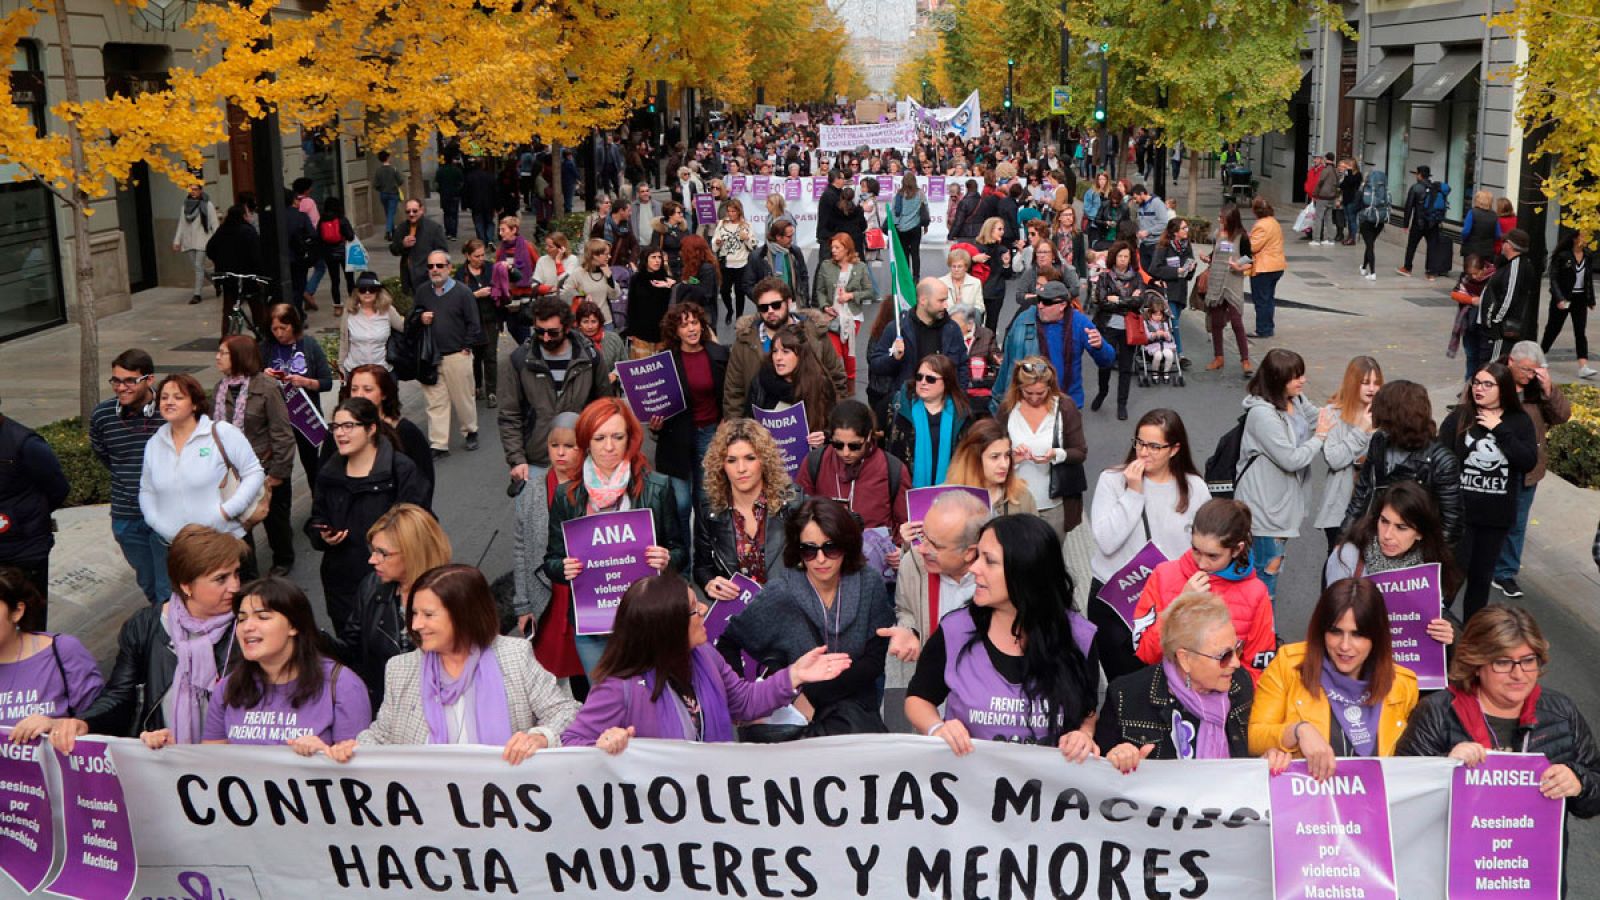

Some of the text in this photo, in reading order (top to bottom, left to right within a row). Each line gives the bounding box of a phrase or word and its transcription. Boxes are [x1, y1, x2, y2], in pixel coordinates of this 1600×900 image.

[630, 361, 664, 376] MARIA
[762, 415, 797, 428] ANDRA
[1460, 473, 1508, 490] MICKEY
[592, 524, 637, 546] ANA
[587, 555, 637, 569] Asesinada
[605, 571, 622, 582] por
[1118, 565, 1153, 591] ANA
[1376, 576, 1430, 593] ATALINA
[1392, 637, 1418, 647] encia
[16, 691, 23, 704] A
[26, 689, 38, 703] LA
[990, 696, 1025, 712] FRENTE
[8, 701, 56, 719] MACHISTA
[243, 711, 297, 726] FRENTE A LA
[968, 709, 1016, 727] VIOLENCIA
[1465, 769, 1542, 786] MARISEL
[0, 780, 45, 800] sesinada
[1291, 775, 1366, 796] DONNA
[10, 800, 30, 811] por
[77, 795, 118, 813] Asesinada
[176, 774, 425, 828] CONTRA
[447, 782, 553, 833] LAS
[576, 770, 960, 831] VIOLENCIAS
[92, 818, 106, 830] por
[1296, 821, 1361, 835] Asesinada
[1471, 815, 1534, 829] Asesinada
[82, 832, 118, 851] violencia
[1492, 838, 1513, 852] por
[1319, 845, 1340, 858] por
[82, 851, 118, 872] Machista
[1474, 855, 1529, 869] violencia
[328, 840, 1211, 900] HACIA MUJERES Y MENORES
[1302, 863, 1361, 877] violencia
[1475, 876, 1531, 890] Machista
[1305, 885, 1365, 898] Machista
